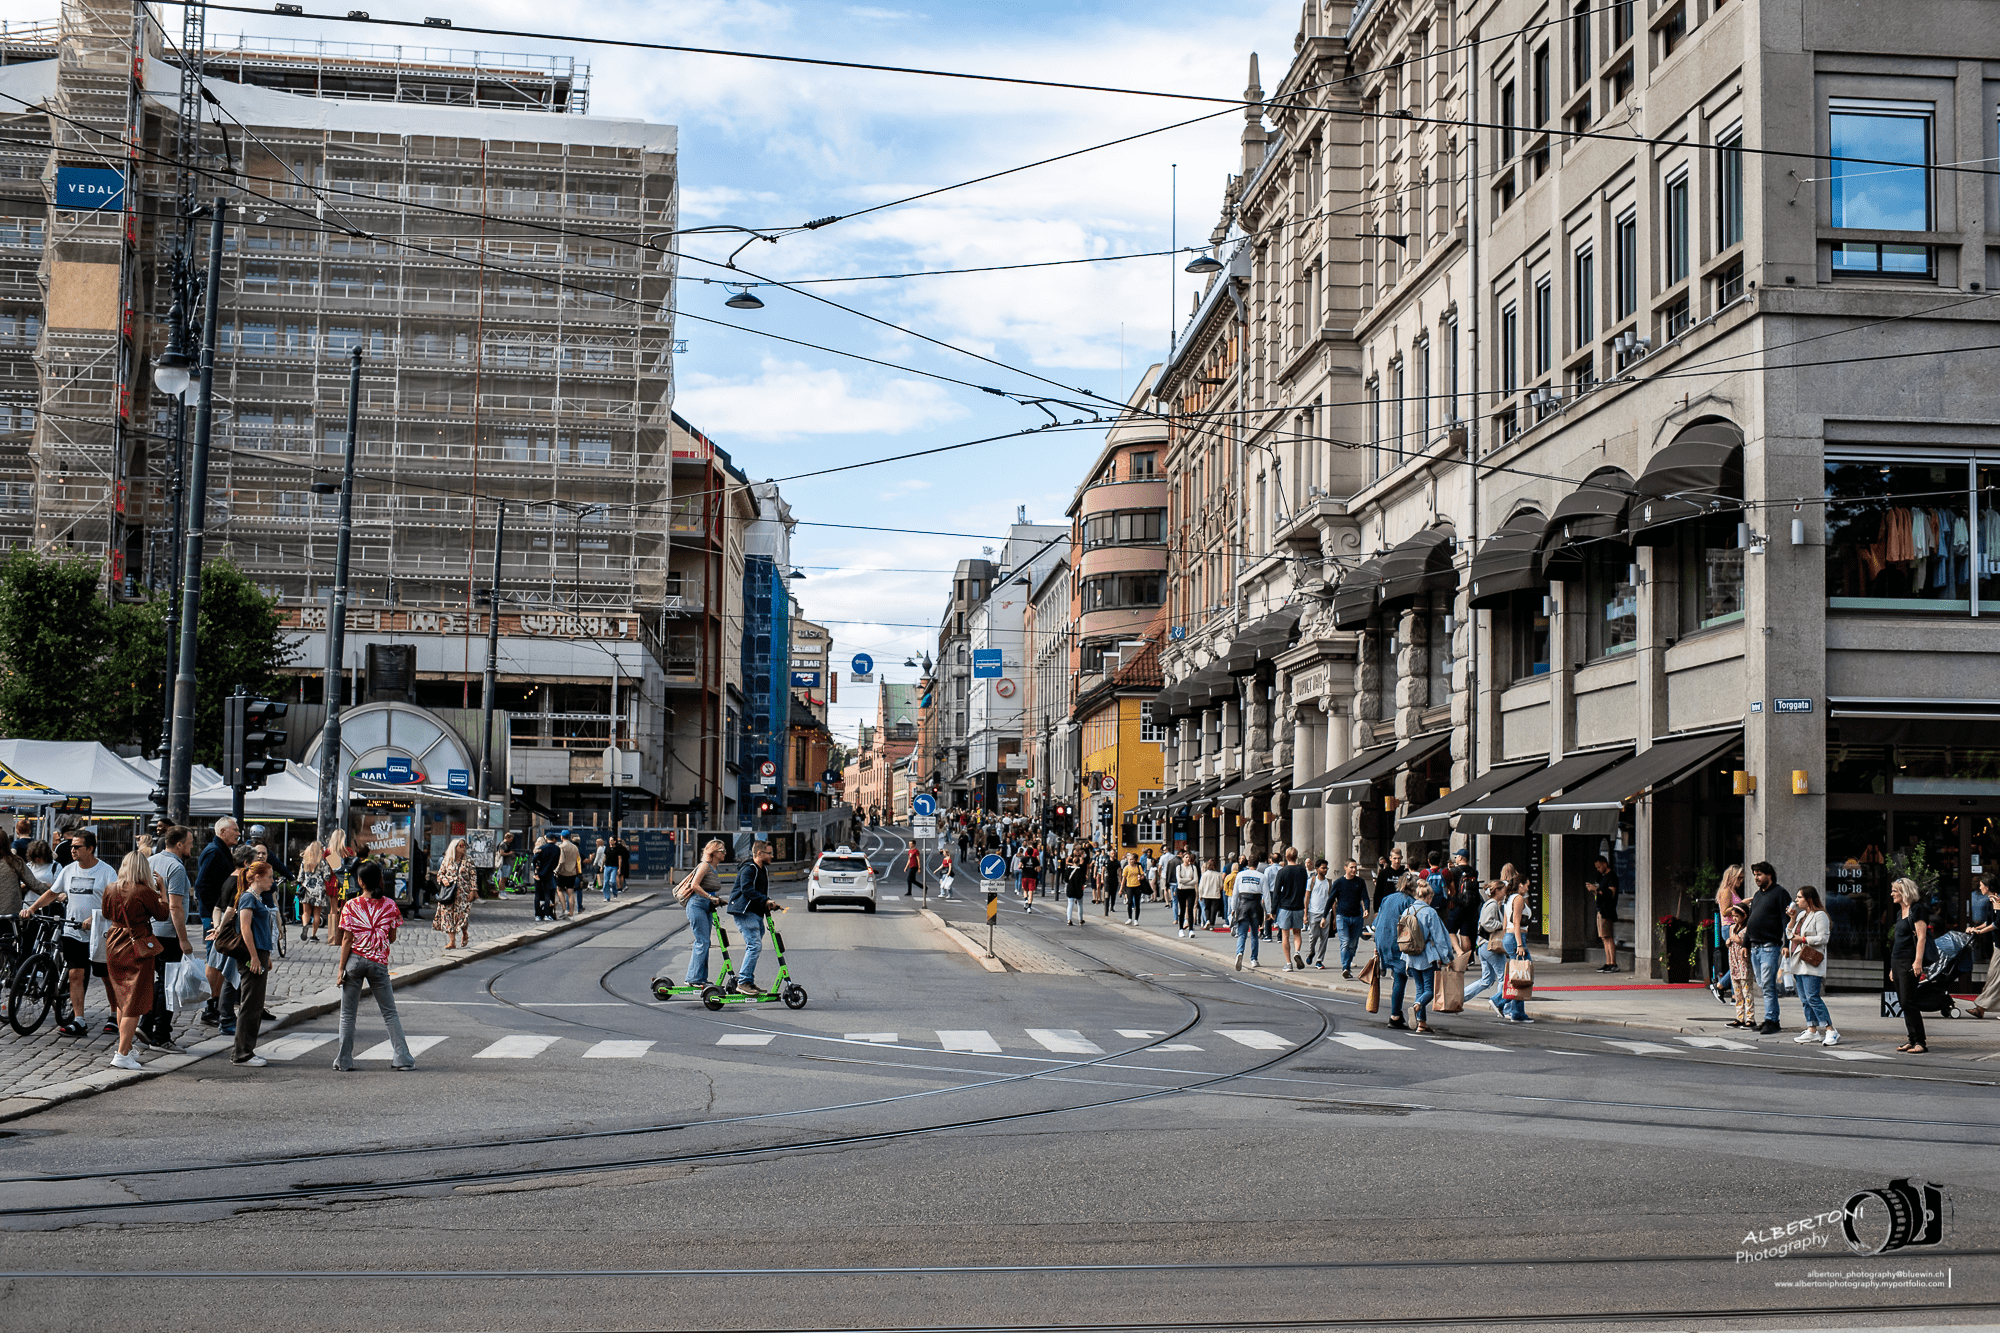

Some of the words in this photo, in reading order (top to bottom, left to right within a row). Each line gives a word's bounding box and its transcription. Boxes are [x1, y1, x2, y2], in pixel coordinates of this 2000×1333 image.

[68, 183, 114, 195] VEDAL
[803, 659, 820, 668] BAR
[1777, 700, 1809, 710] Torggata
[370, 820, 393, 834] BRYT
[365, 837, 406, 850] SMAKENE
[1837, 868, 1863, 878] 10-19
[1837, 883, 1863, 894] 10-18
